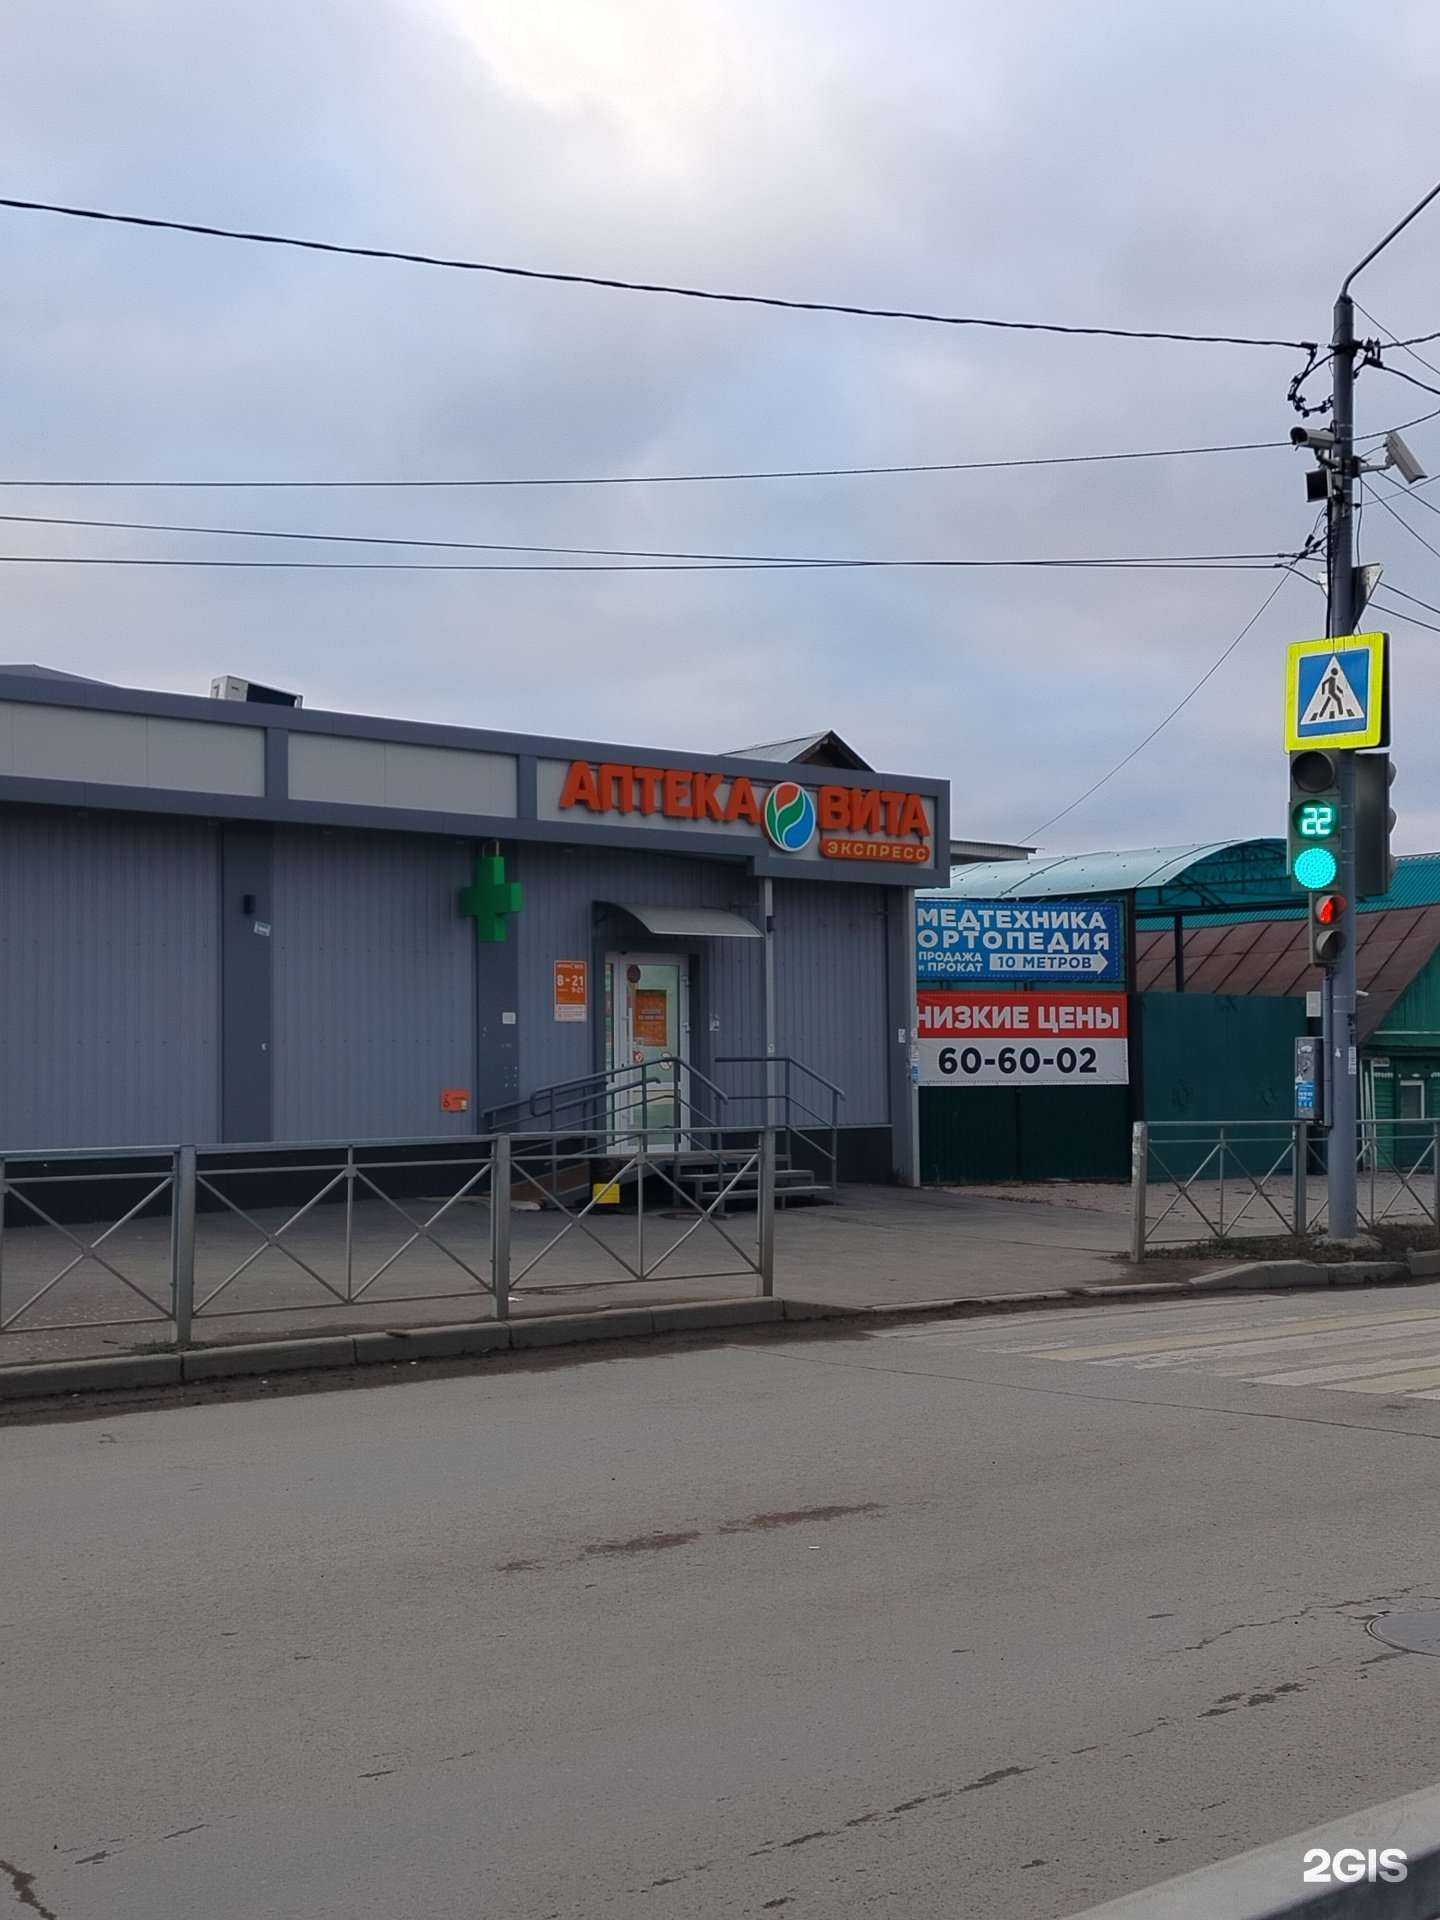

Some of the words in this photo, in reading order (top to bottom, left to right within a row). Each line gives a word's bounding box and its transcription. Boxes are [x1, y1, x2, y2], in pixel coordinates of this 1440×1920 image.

[560, 761, 762, 825] АПТЕКА
[818, 785, 930, 837] ВИТА
[1301, 807, 1332, 835] 22
[827, 841, 926, 860] ЭКСПРЕСС
[917, 908, 1107, 930] МЕДТЕХНИКА
[917, 929, 1110, 953] ОРТОПЕДИЯ
[918, 951, 983, 963] ПРОДАЖА
[927, 962, 984, 973] ПРОКАТ
[998, 956, 1016, 969] 10
[1022, 956, 1092, 969] МЕТРОВ
[916, 1005, 1029, 1030] НИЗКИЕ
[1037, 1006, 1120, 1033] ЦЕНЫ
[938, 1046, 1098, 1075] 60-60-02
